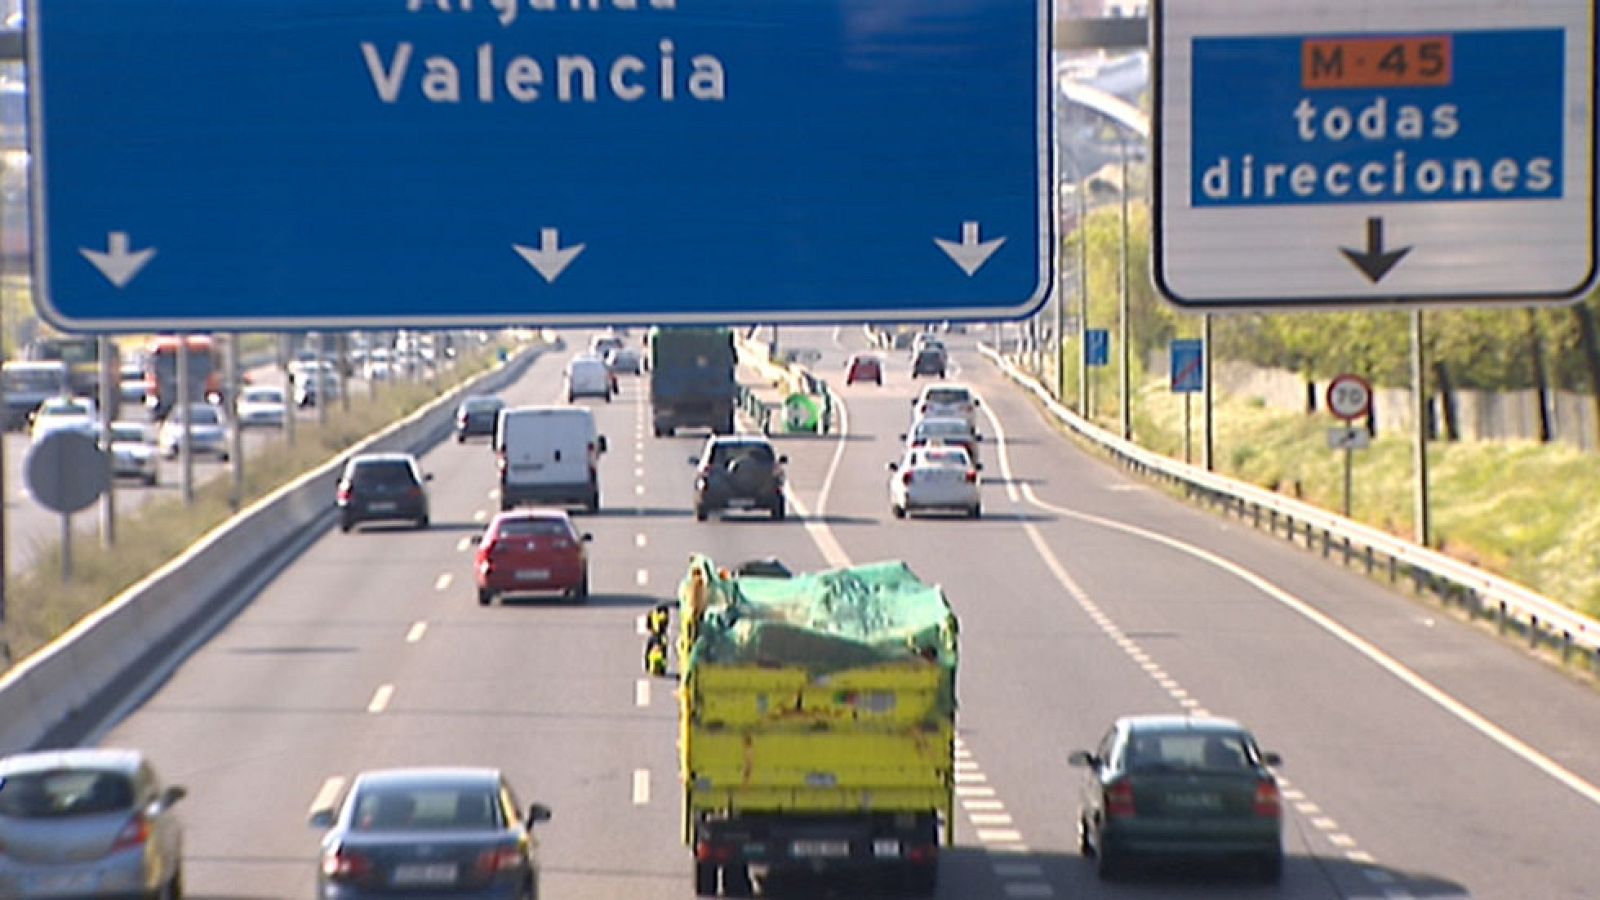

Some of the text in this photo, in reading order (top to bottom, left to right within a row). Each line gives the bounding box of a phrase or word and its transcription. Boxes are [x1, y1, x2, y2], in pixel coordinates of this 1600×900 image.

[360, 40, 726, 103] Valencia
[1294, 97, 1459, 140] todas
[1202, 151, 1554, 198] direcciones
